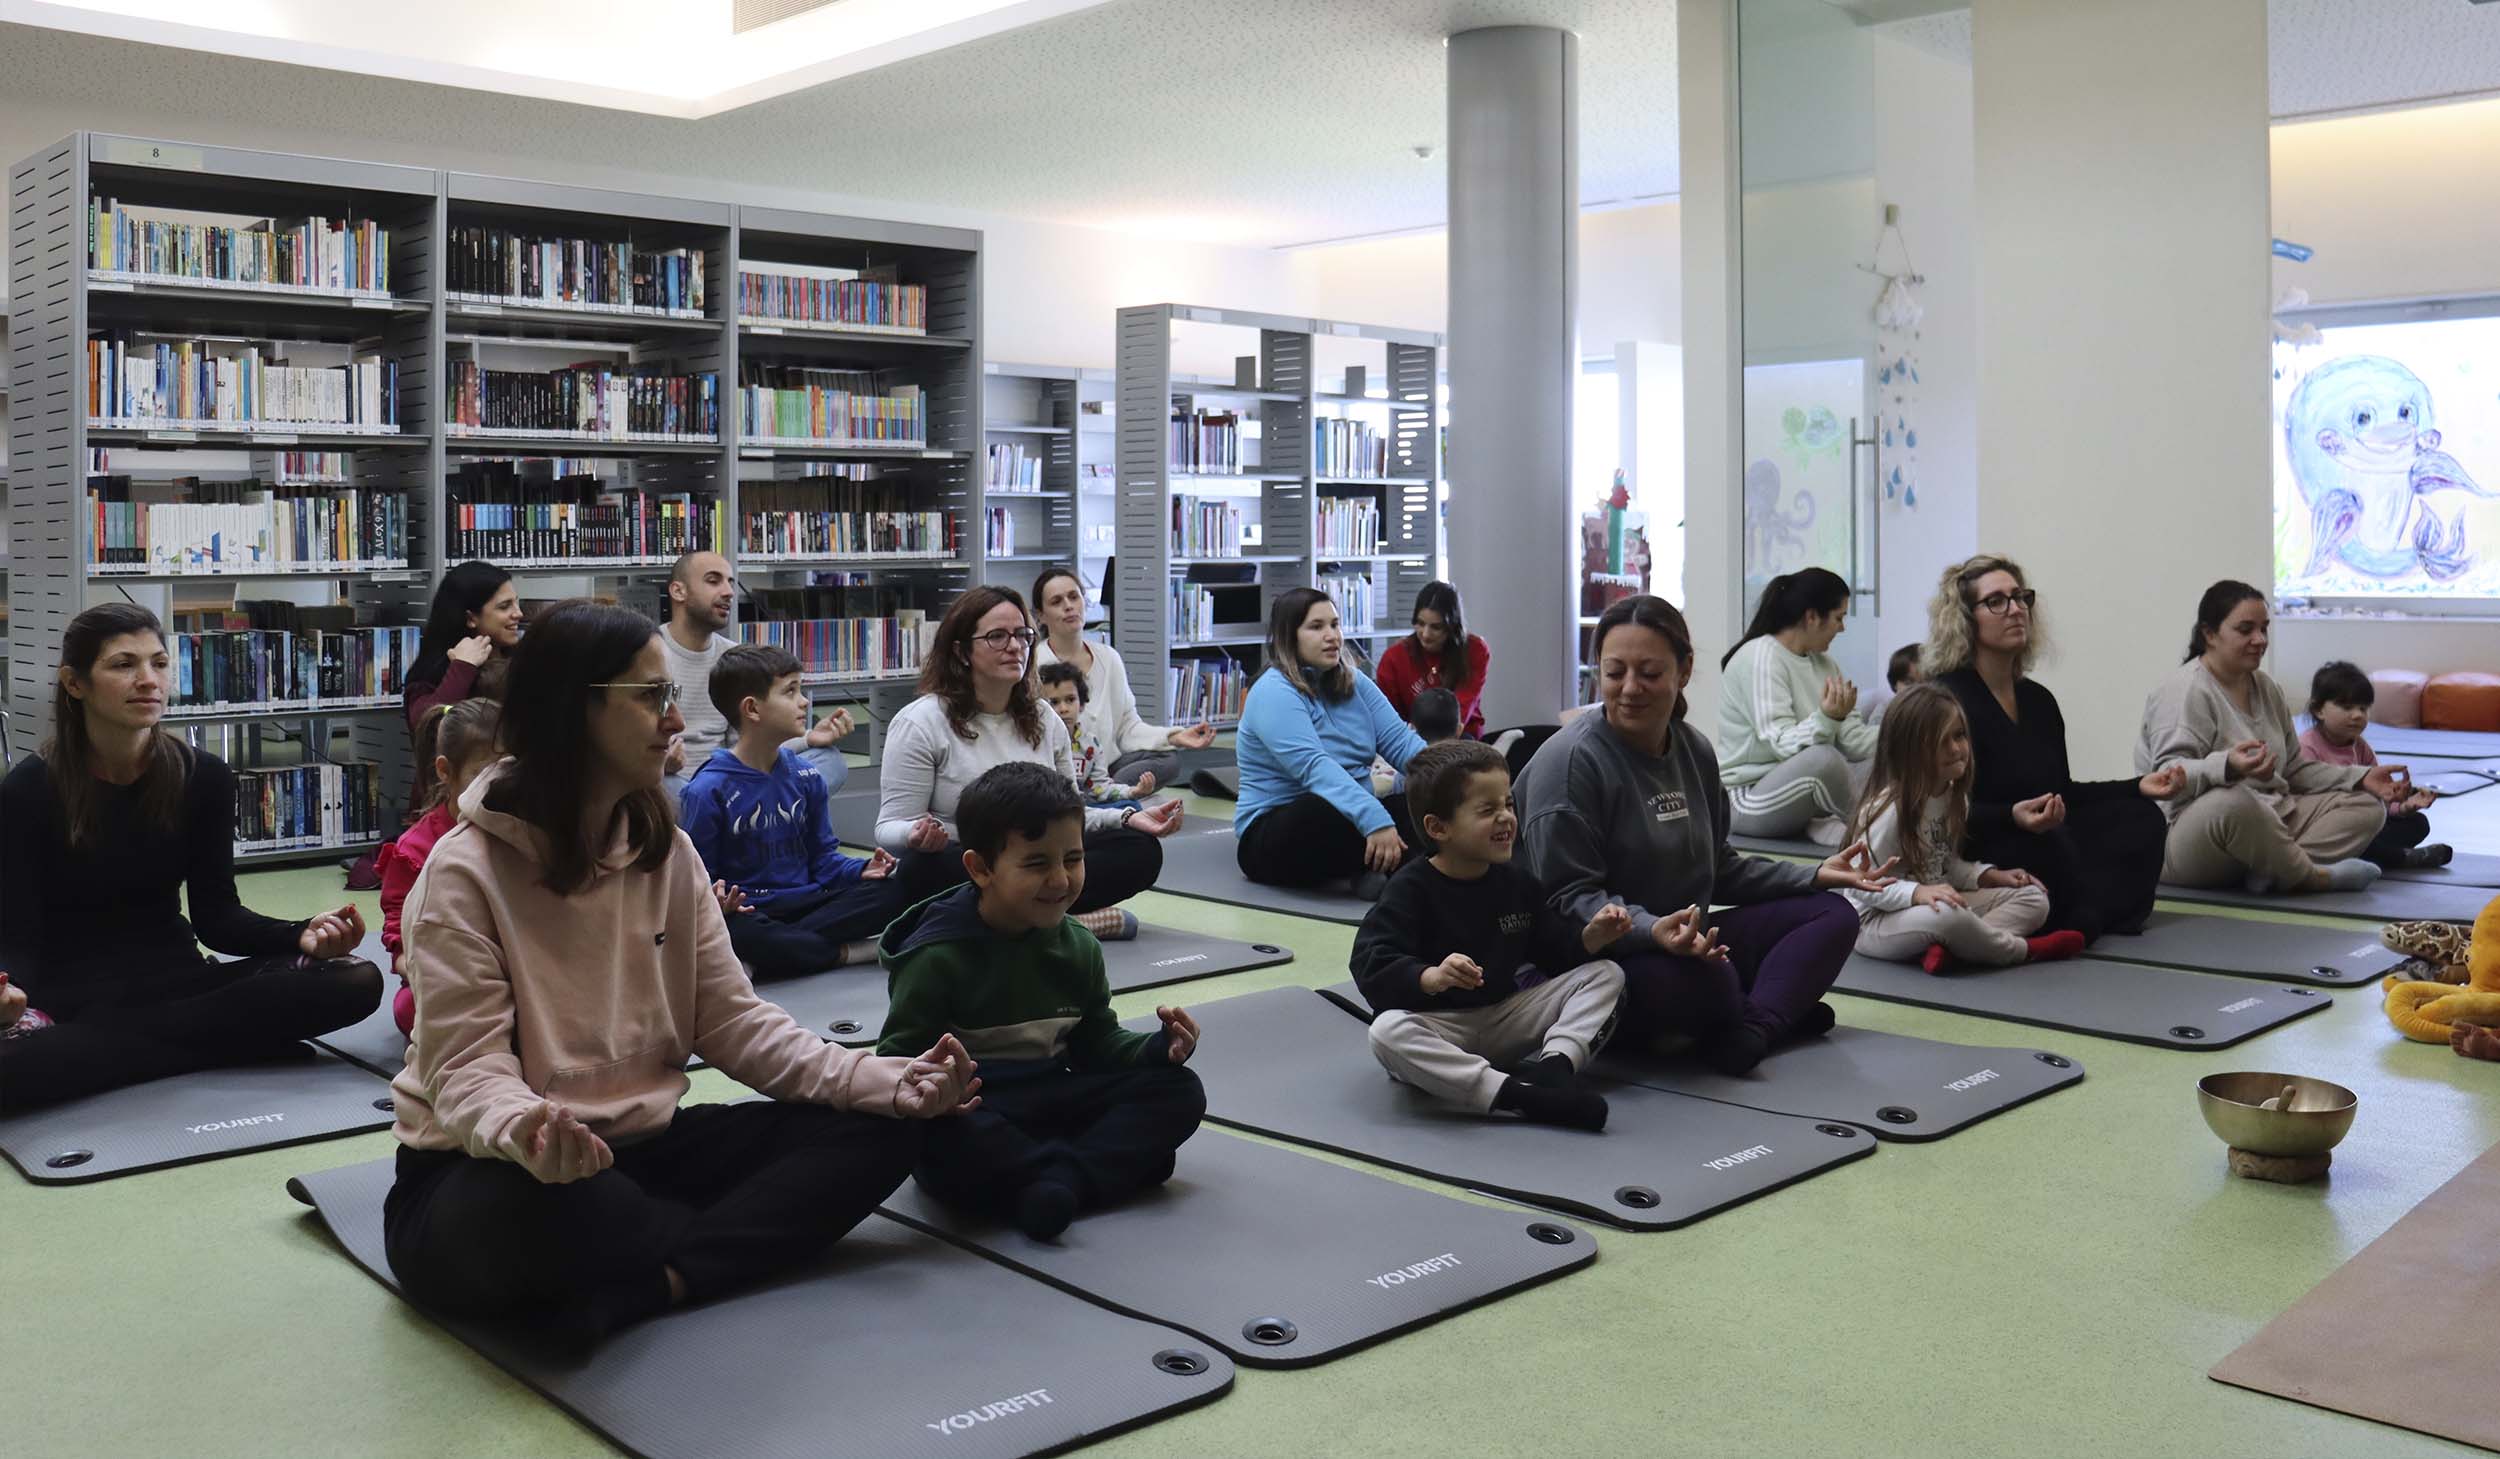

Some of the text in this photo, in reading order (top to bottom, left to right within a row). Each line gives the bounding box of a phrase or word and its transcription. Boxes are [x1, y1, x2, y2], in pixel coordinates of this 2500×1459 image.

[152, 148, 160, 158] 8
[1658, 800, 1681, 812] CITY
[185, 1113, 285, 1134] YOURFIT
[1702, 1144, 1774, 1171] YOURFIT
[1366, 1253, 1462, 1288] YOURFIT
[926, 1388, 1054, 1435] YOURFIT
